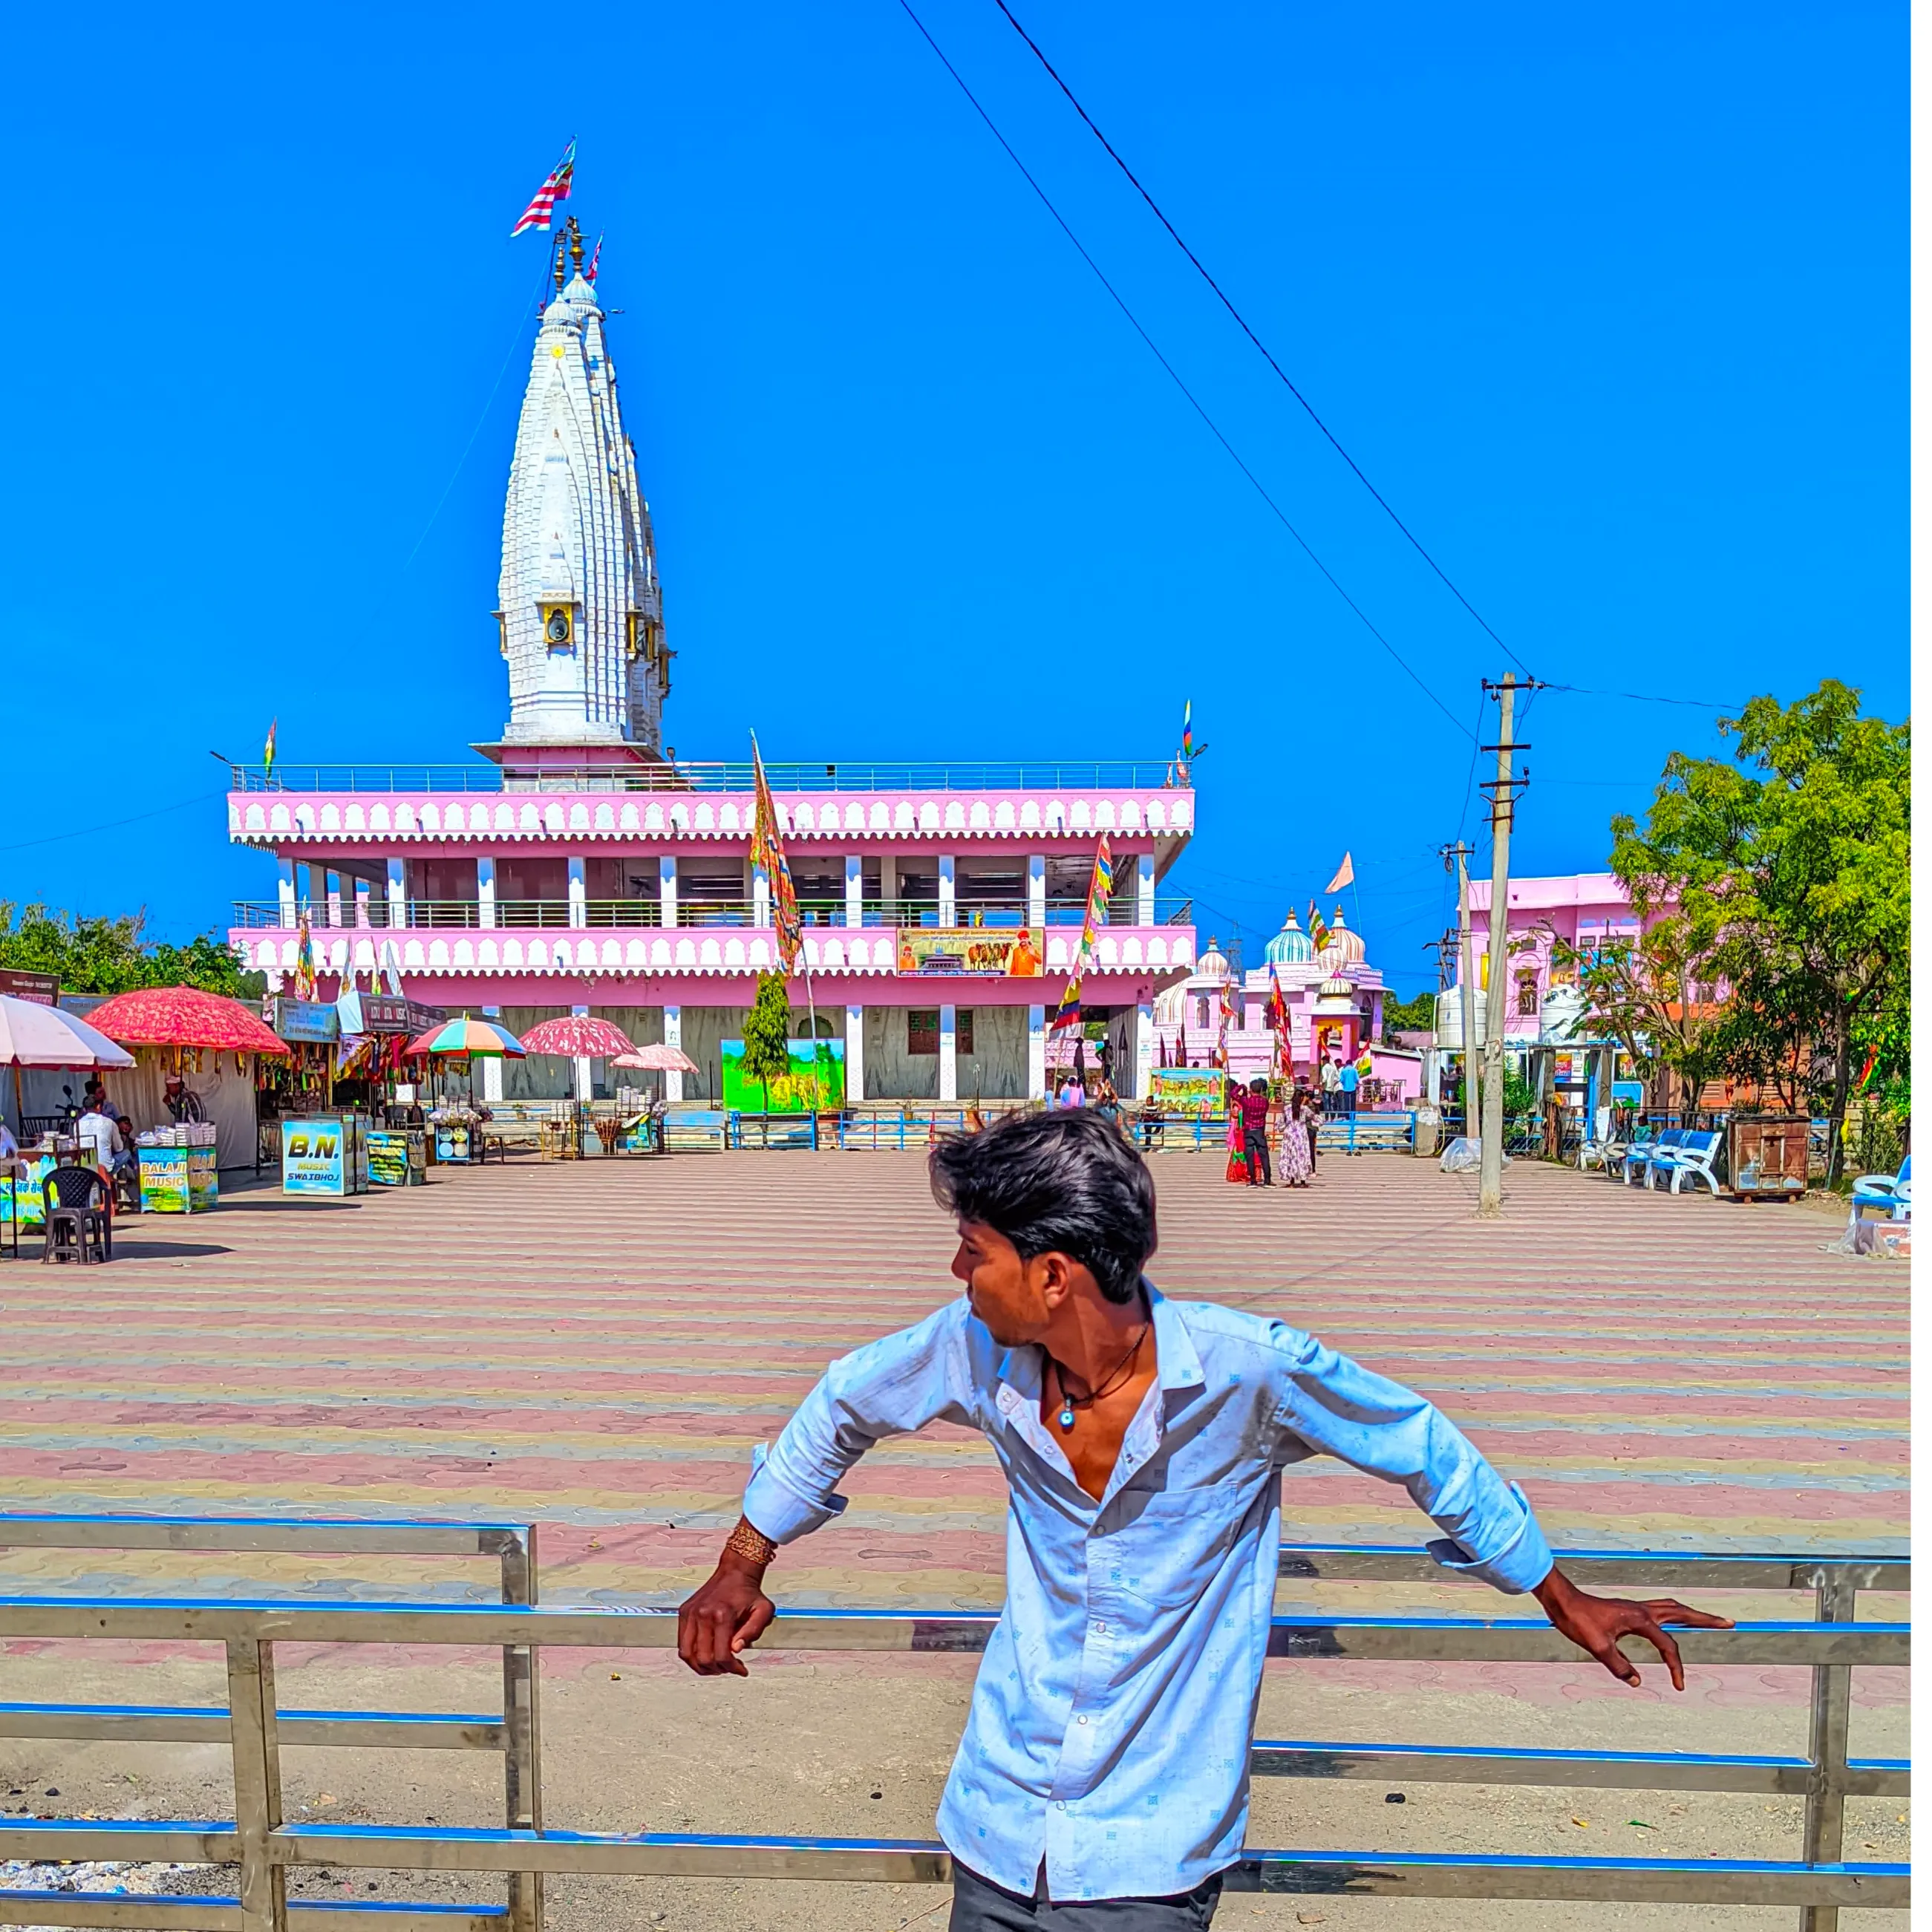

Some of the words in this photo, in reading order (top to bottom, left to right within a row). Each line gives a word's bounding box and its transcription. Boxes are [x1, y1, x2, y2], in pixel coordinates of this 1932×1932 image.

[288, 1135, 339, 1158] B.N.
[140, 1162, 186, 1174] BALAJI
[145, 1176, 185, 1187] MUSIC
[287, 1172, 339, 1181] SWAIBHOJ
